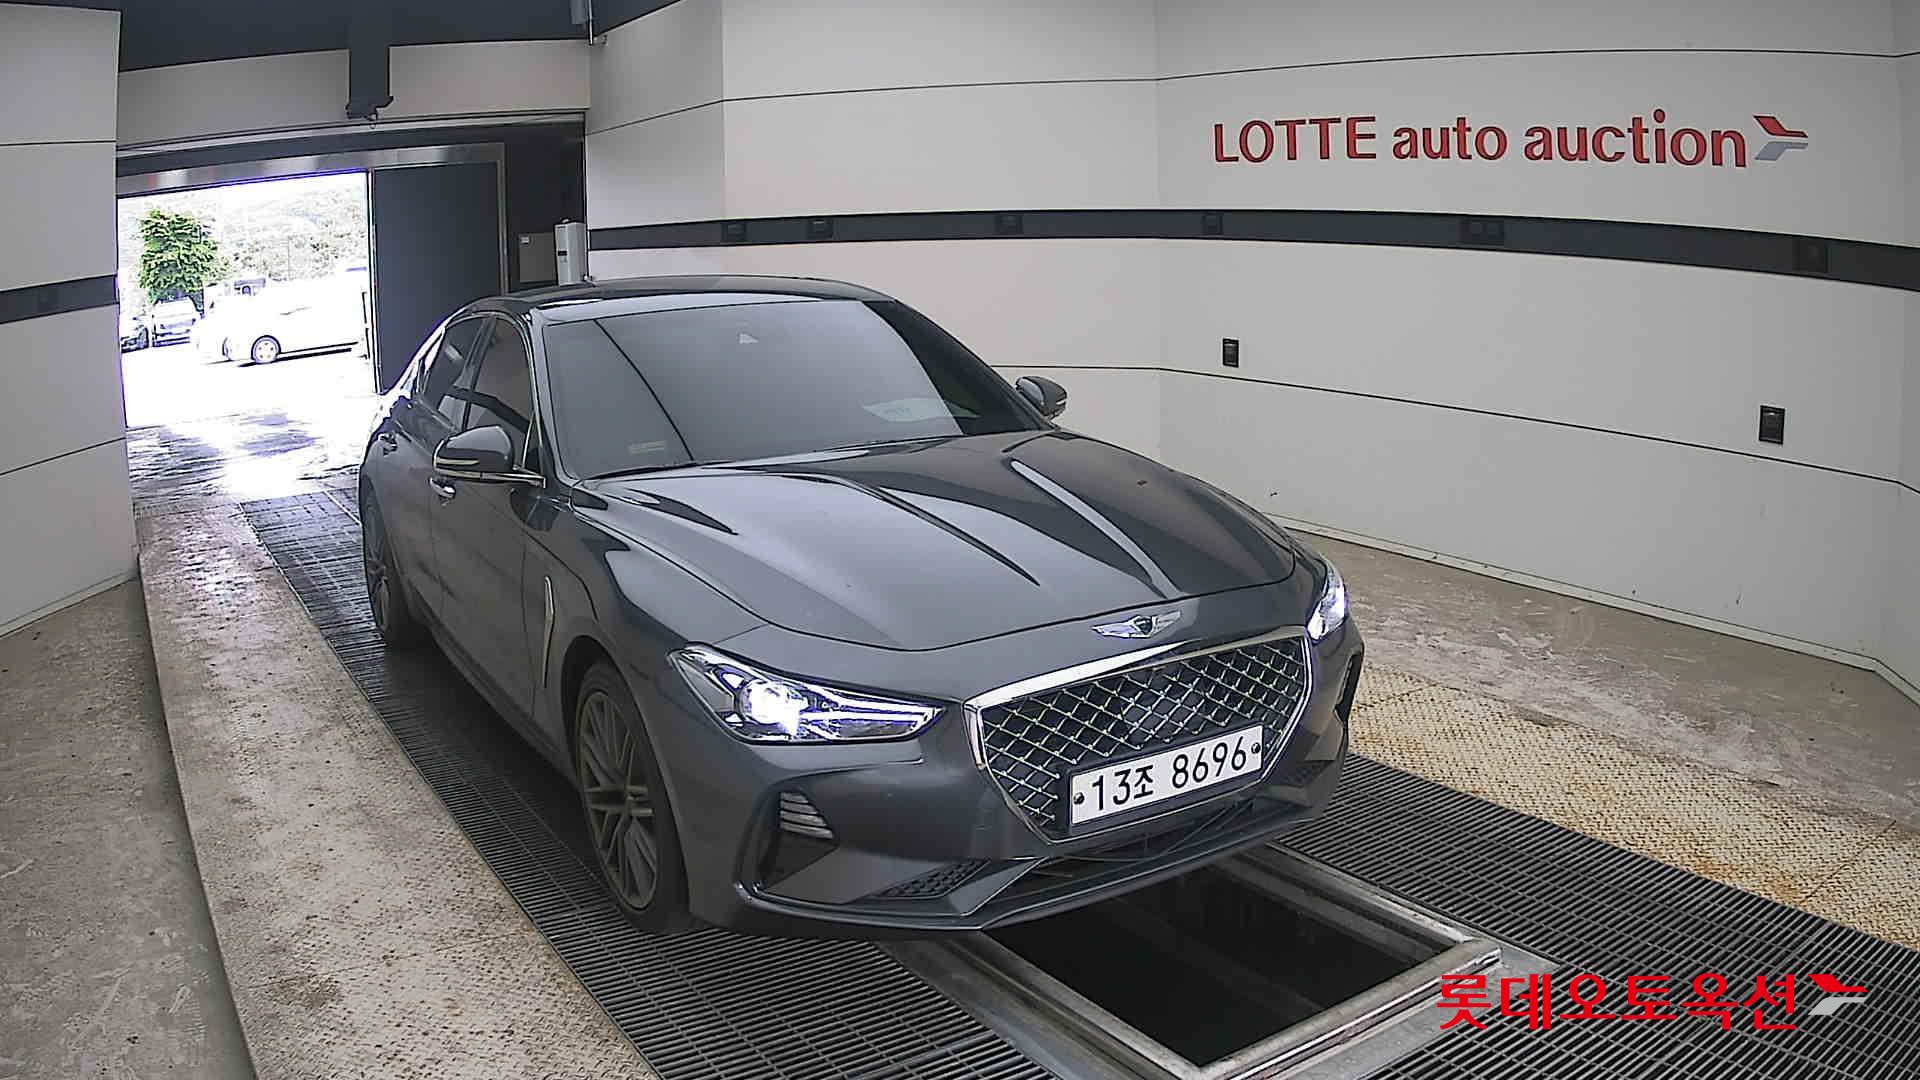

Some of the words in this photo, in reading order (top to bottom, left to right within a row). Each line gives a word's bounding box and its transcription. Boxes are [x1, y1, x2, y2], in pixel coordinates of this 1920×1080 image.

[1214, 116, 1376, 163] LOTTE
[1392, 117, 1508, 160] auto
[1523, 108, 1748, 168] auction
[1091, 764, 1154, 812] 13조
[1171, 735, 1247, 789] 8696
